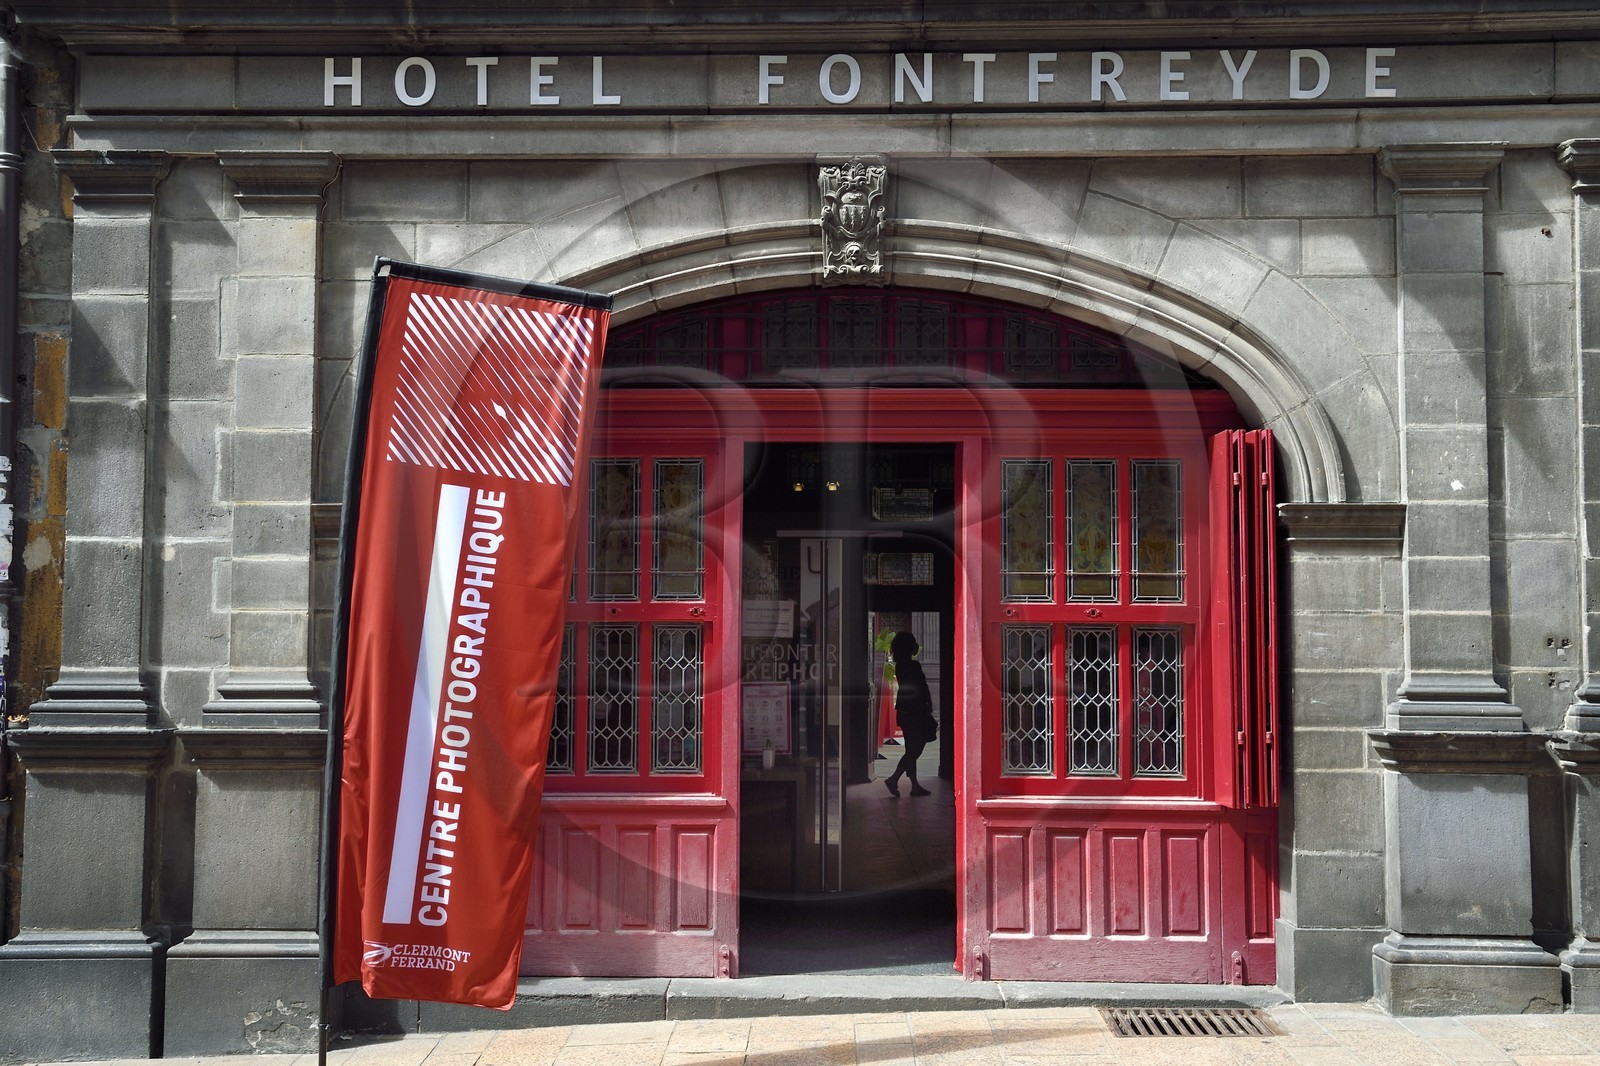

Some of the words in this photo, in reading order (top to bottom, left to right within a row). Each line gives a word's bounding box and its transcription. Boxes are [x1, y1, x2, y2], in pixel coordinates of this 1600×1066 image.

[324, 56, 621, 107] HOTEL
[758, 47, 1398, 104] FONTFREYDE
[436, 488, 506, 794] PHOTOGRAPHIQUE
[418, 800, 461, 927] CENTRE
[390, 956, 456, 972] FERRAND
[393, 944, 471, 963] CLERMONT
